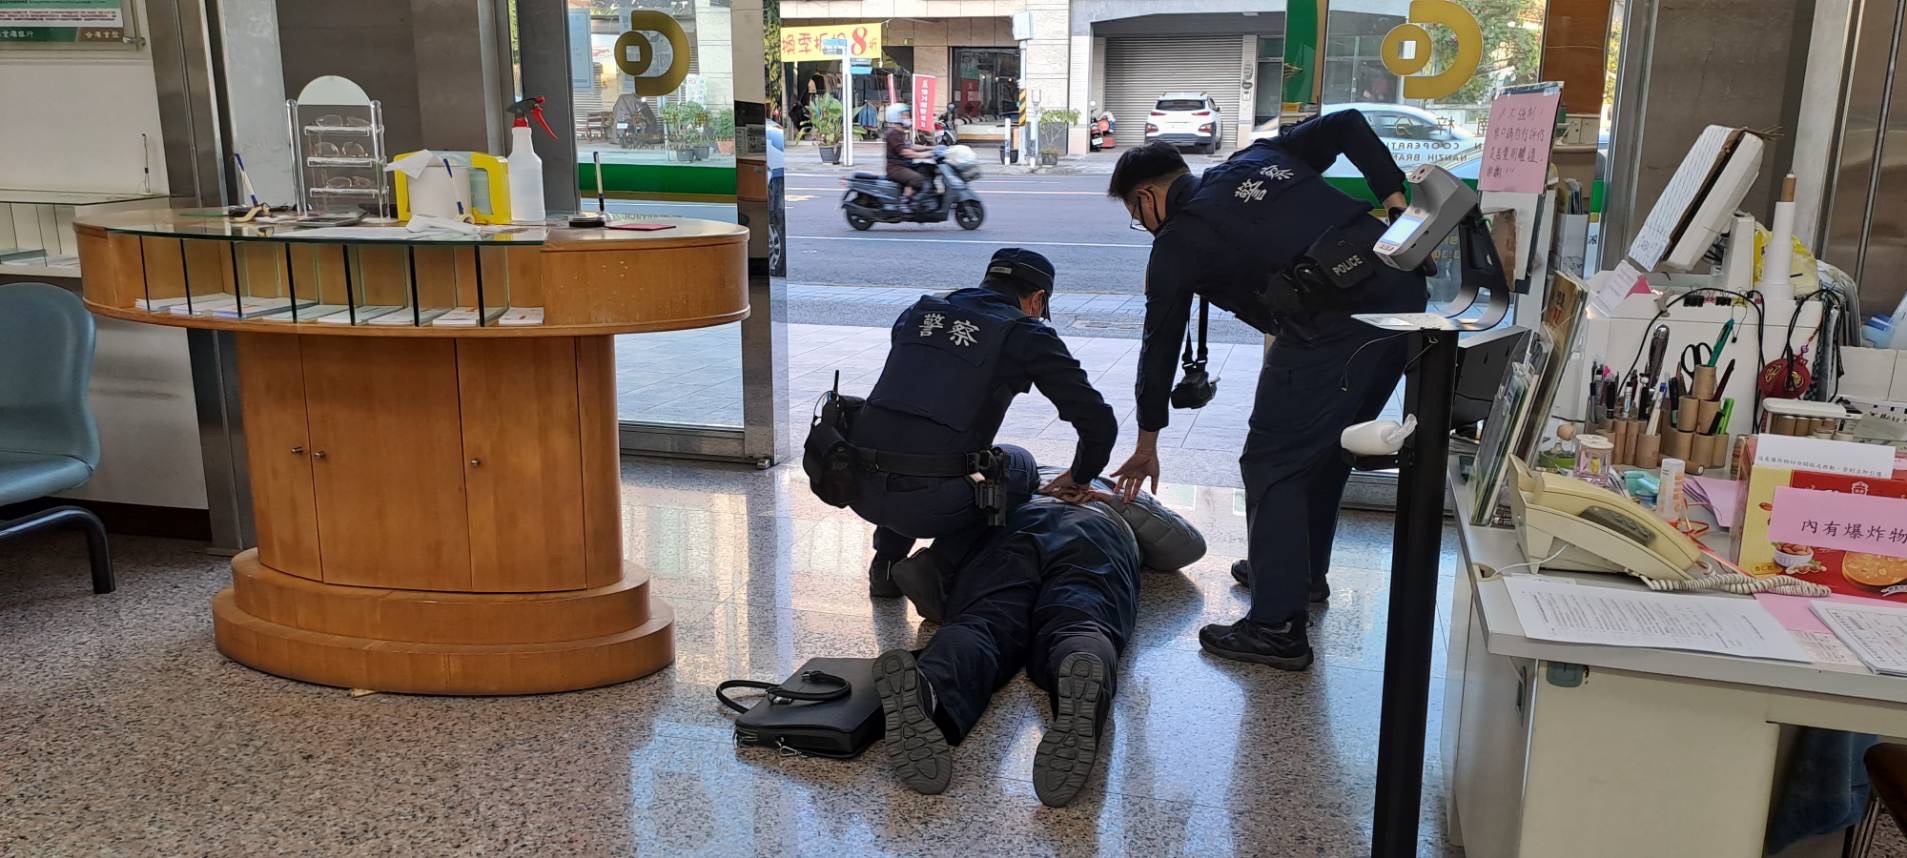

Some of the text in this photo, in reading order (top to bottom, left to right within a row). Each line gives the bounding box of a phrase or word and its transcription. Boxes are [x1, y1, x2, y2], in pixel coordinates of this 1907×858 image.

[1234, 165, 1295, 204] 警察
[1332, 254, 1364, 277] POLICE
[918, 312, 980, 347] 警察
[1801, 519, 1907, 545] 內有爆炸物
